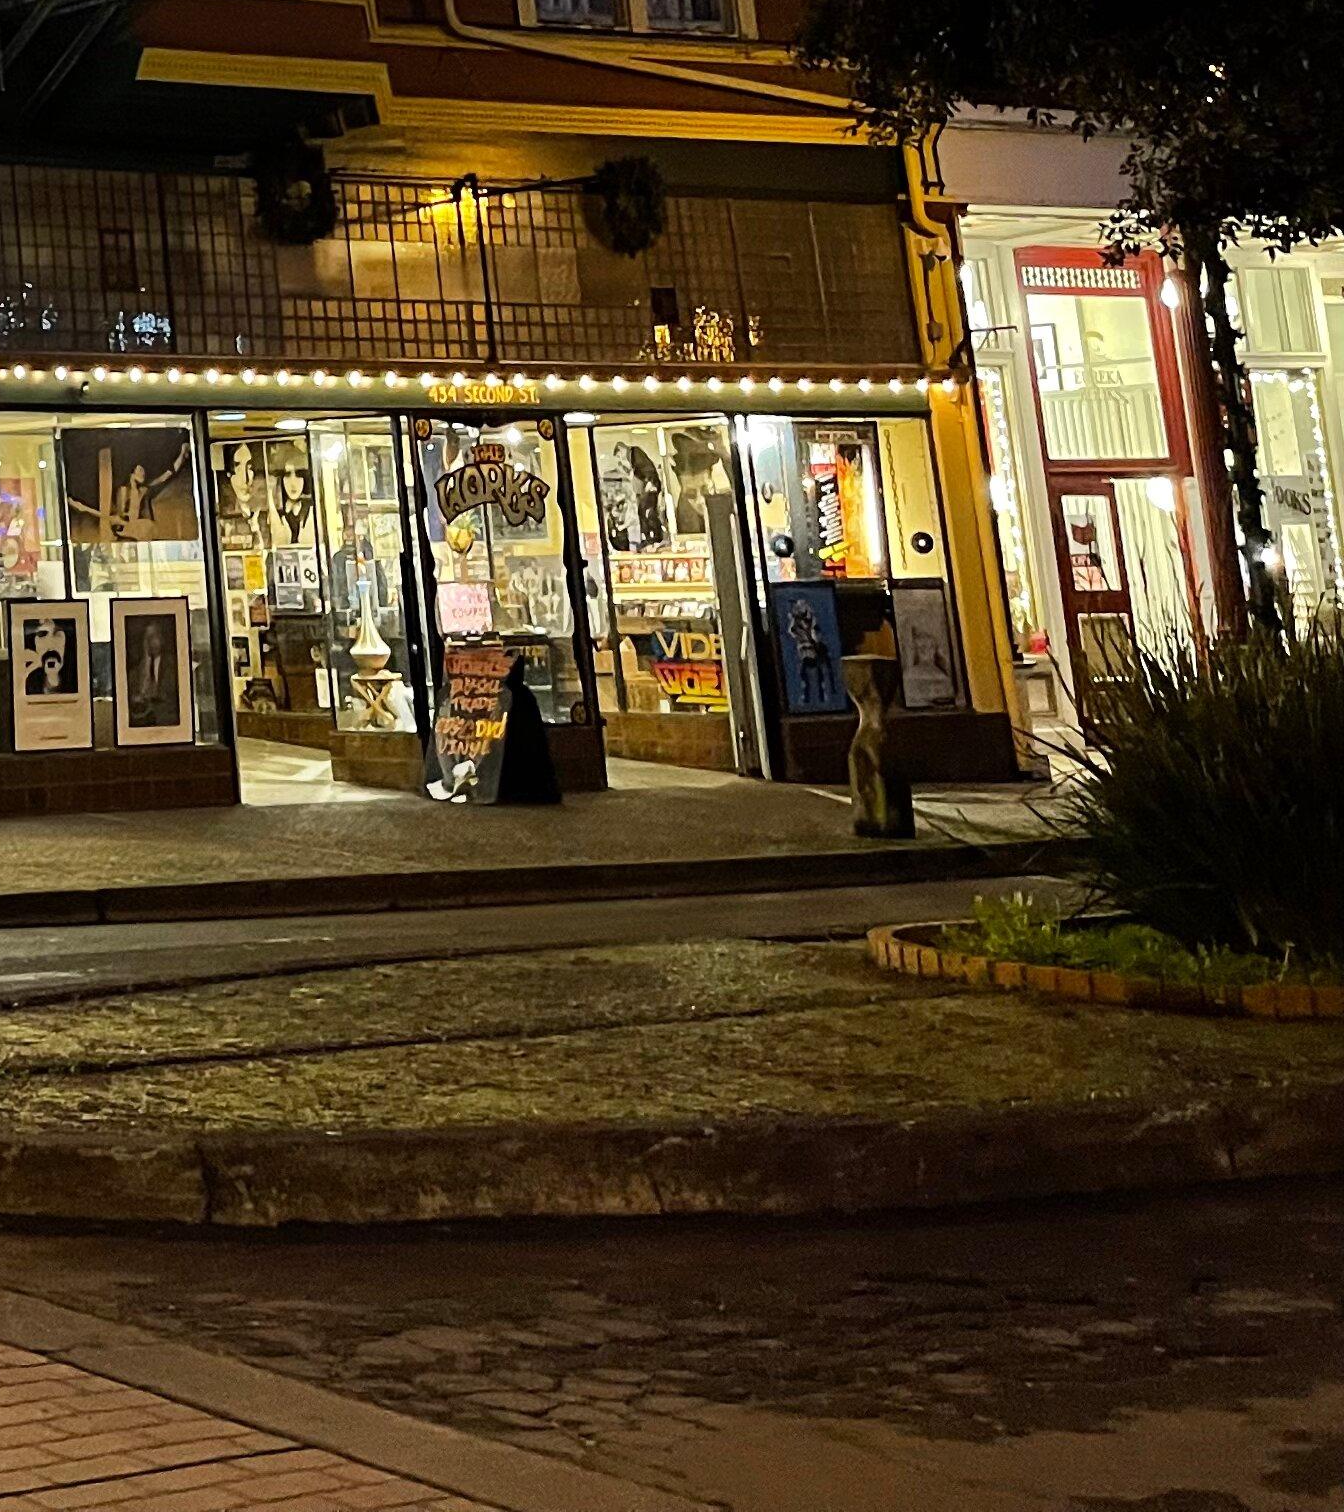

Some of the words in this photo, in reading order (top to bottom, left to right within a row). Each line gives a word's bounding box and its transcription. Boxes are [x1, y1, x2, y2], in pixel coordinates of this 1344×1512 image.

[428, 386, 458, 403] 434
[464, 385, 514, 404] SECOND
[471, 443, 506, 464] THE
[434, 463, 551, 527] WORKS
[655, 631, 722, 660] VIDE
[653, 662, 724, 696] WOR
